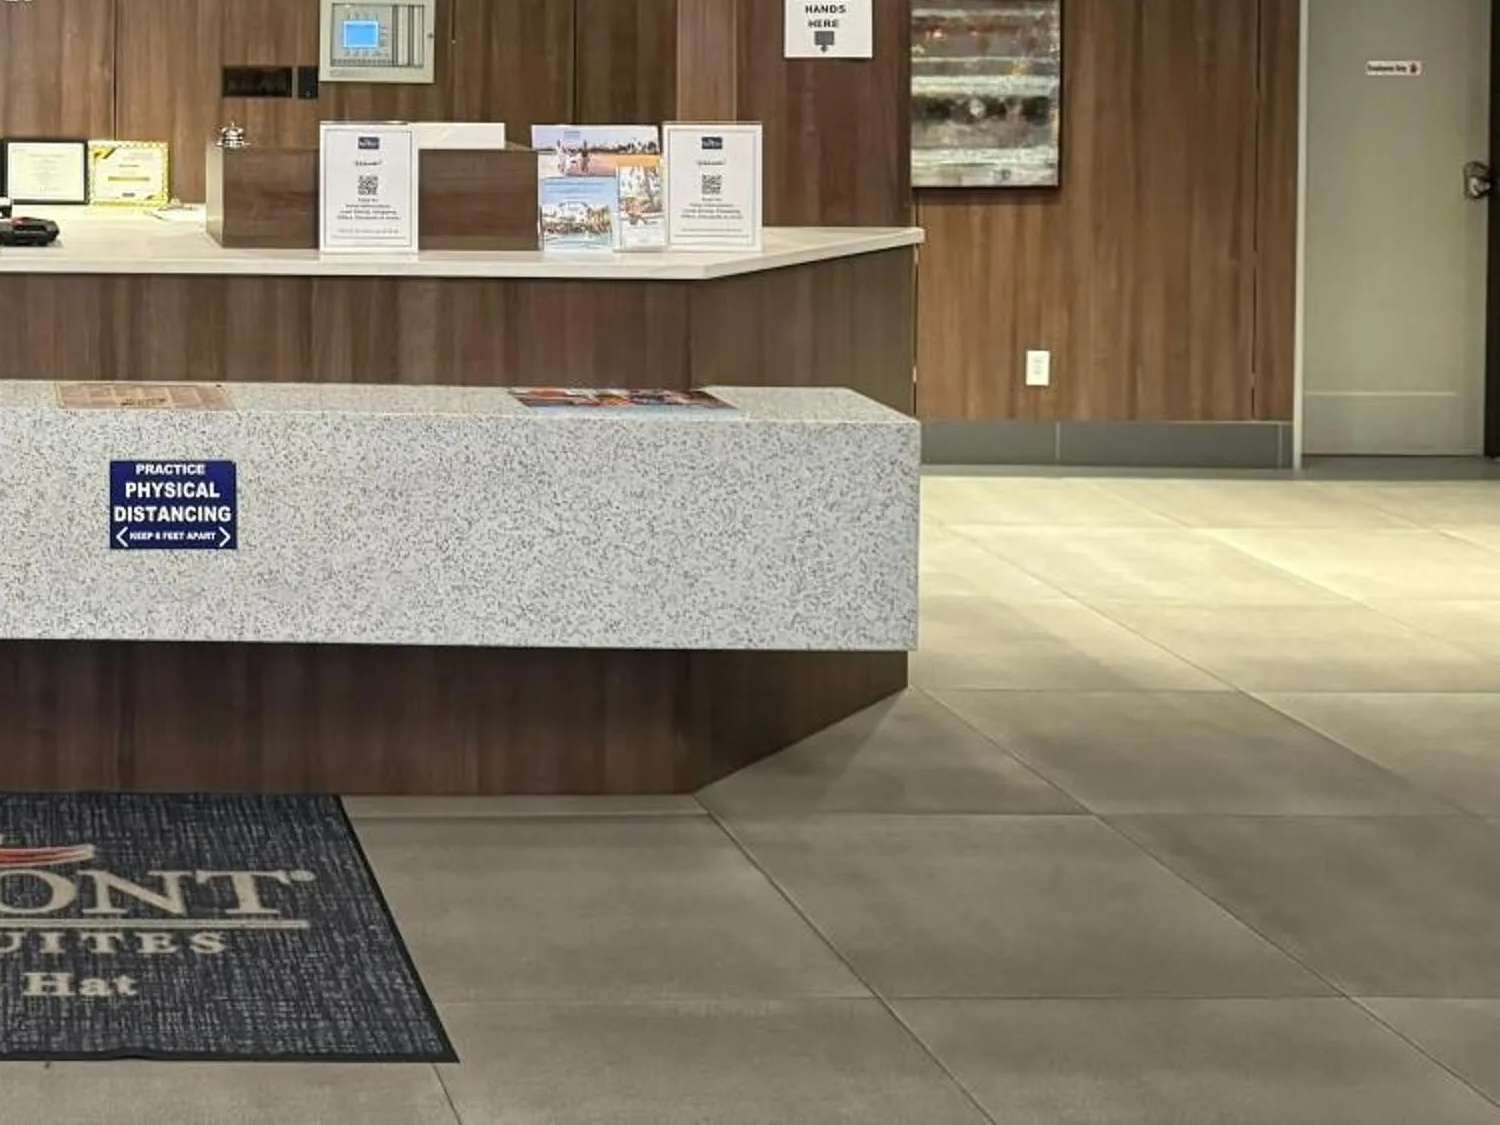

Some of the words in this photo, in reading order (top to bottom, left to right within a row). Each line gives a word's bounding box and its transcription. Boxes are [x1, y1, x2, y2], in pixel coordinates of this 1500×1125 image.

[805, 4, 847, 14] HANDS
[808, 19, 839, 28] HERE
[135, 463, 206, 475] PRACTICE
[125, 481, 221, 498] PHYSICAL
[113, 505, 232, 523] DISTANCING
[22, 970, 138, 997] Hat
